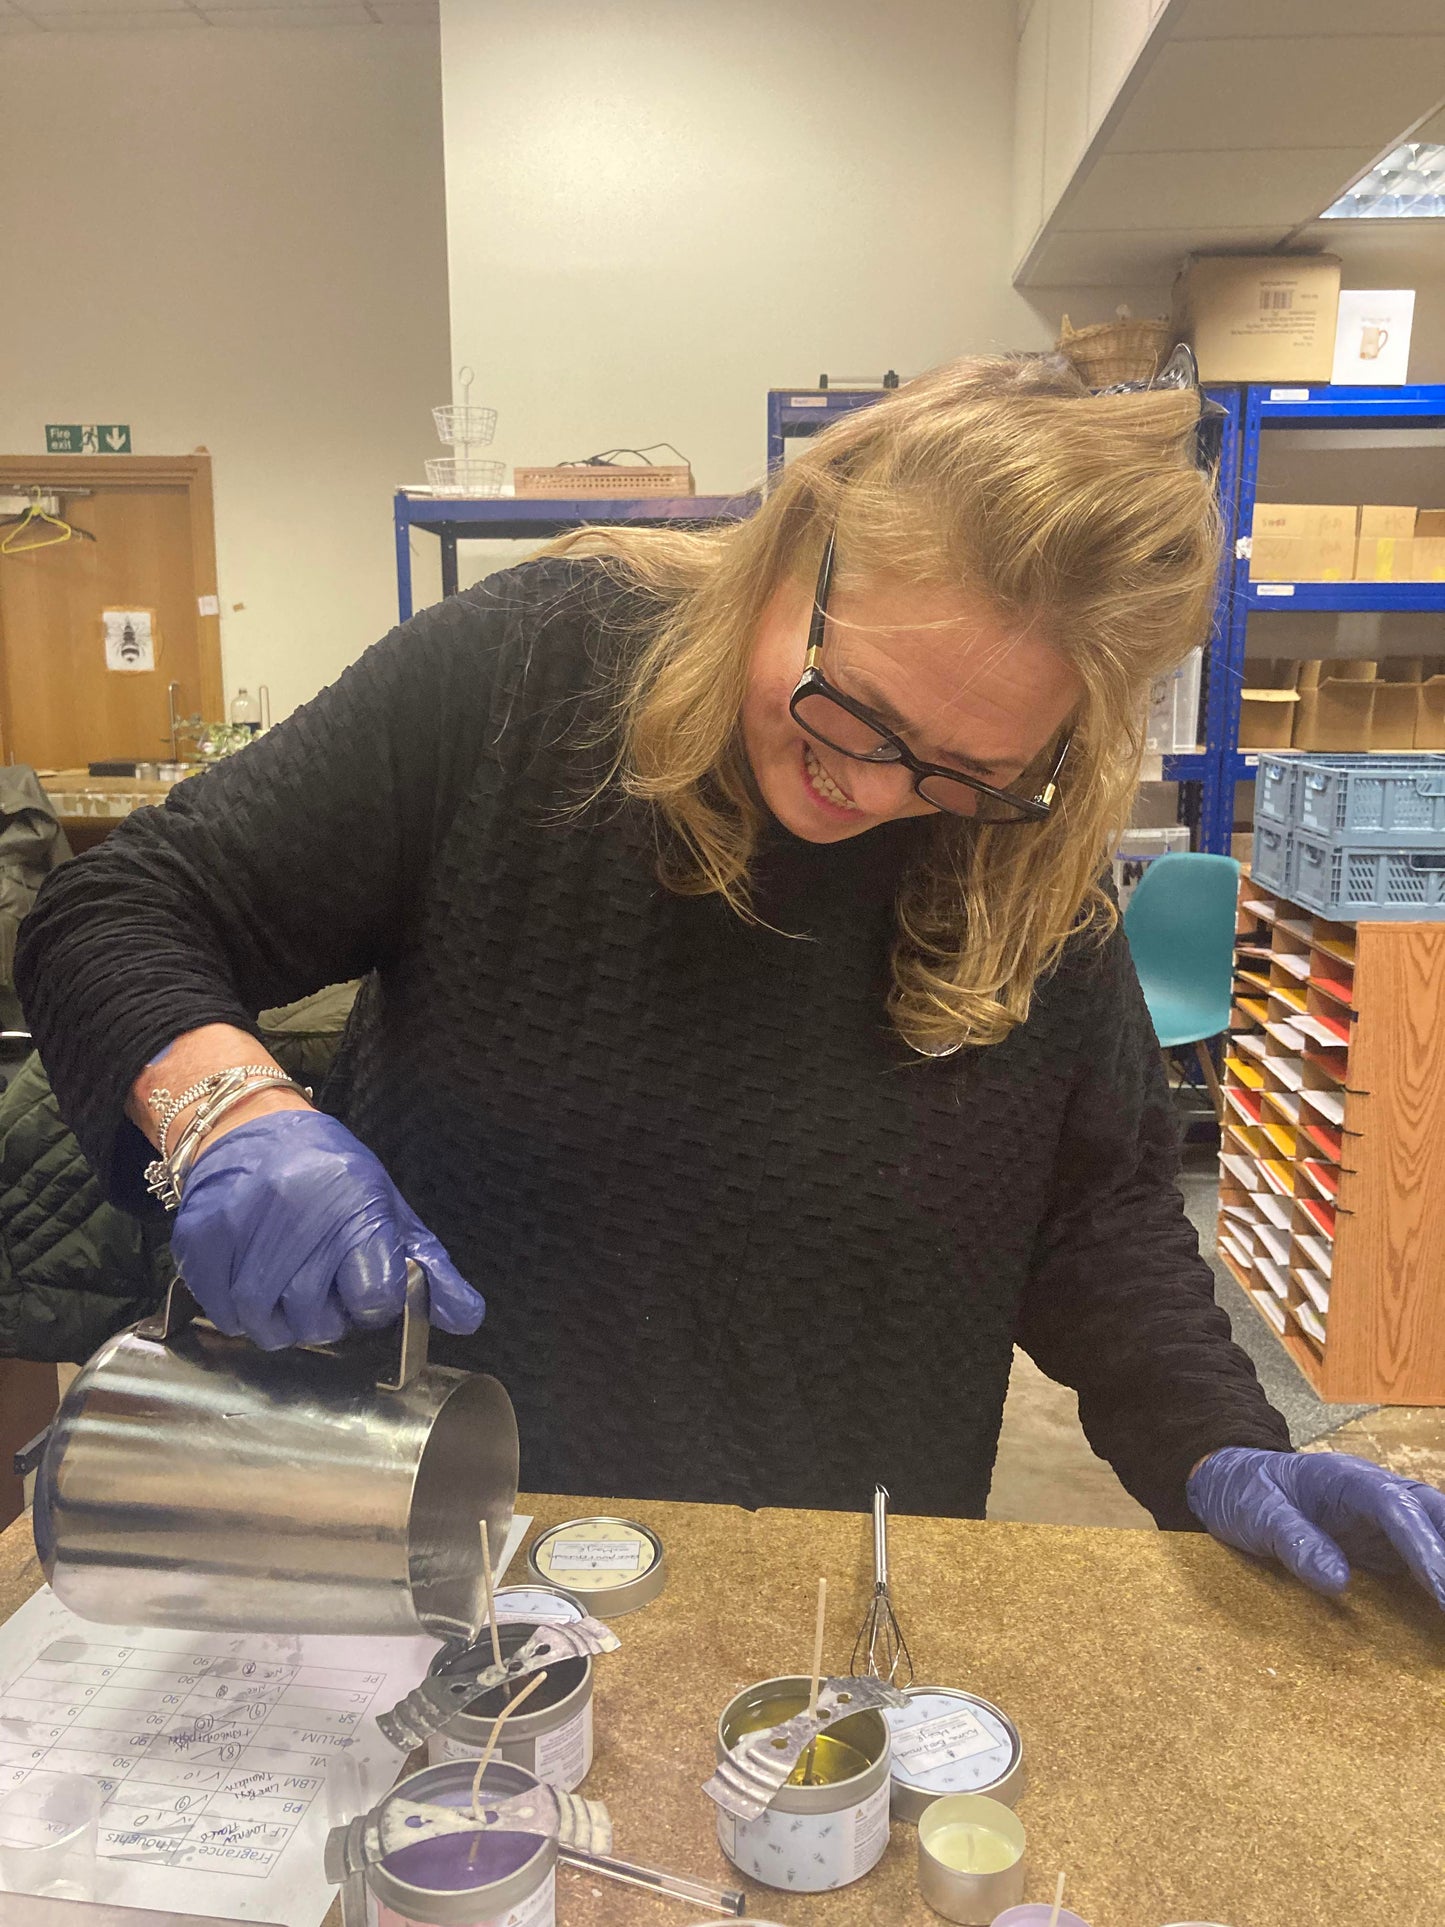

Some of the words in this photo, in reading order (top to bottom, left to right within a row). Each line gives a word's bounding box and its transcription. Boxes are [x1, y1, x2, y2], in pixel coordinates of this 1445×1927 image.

[50, 427, 71, 439] Fire
[51, 441, 71, 450] exit
[118, 1650, 129, 1658] 9
[192, 1658, 211, 1666] 90
[101, 1668, 113, 1677] 9
[178, 1676, 196, 1684] 90
[362, 1674, 380, 1684] PF
[85, 1687, 96, 1696] 9
[162, 1695, 181, 1704] 90
[349, 1693, 369, 1704] FC
[67, 1707, 79, 1716] 9
[146, 1715, 164, 1724] 90
[338, 1713, 357, 1724] SR
[50, 1727, 61, 1737] 9
[129, 1736, 148, 1746] 90
[301, 1732, 345, 1746] PLUM
[31, 1750, 43, 1758] 9
[112, 1758, 131, 1768] 90
[283, 1777, 317, 1790] LBM
[282, 1802, 304, 1814] PB
[269, 1826, 289, 1838] LF
[105, 1832, 174, 1853] Thoughts
[198, 1845, 274, 1865] Fragrance
